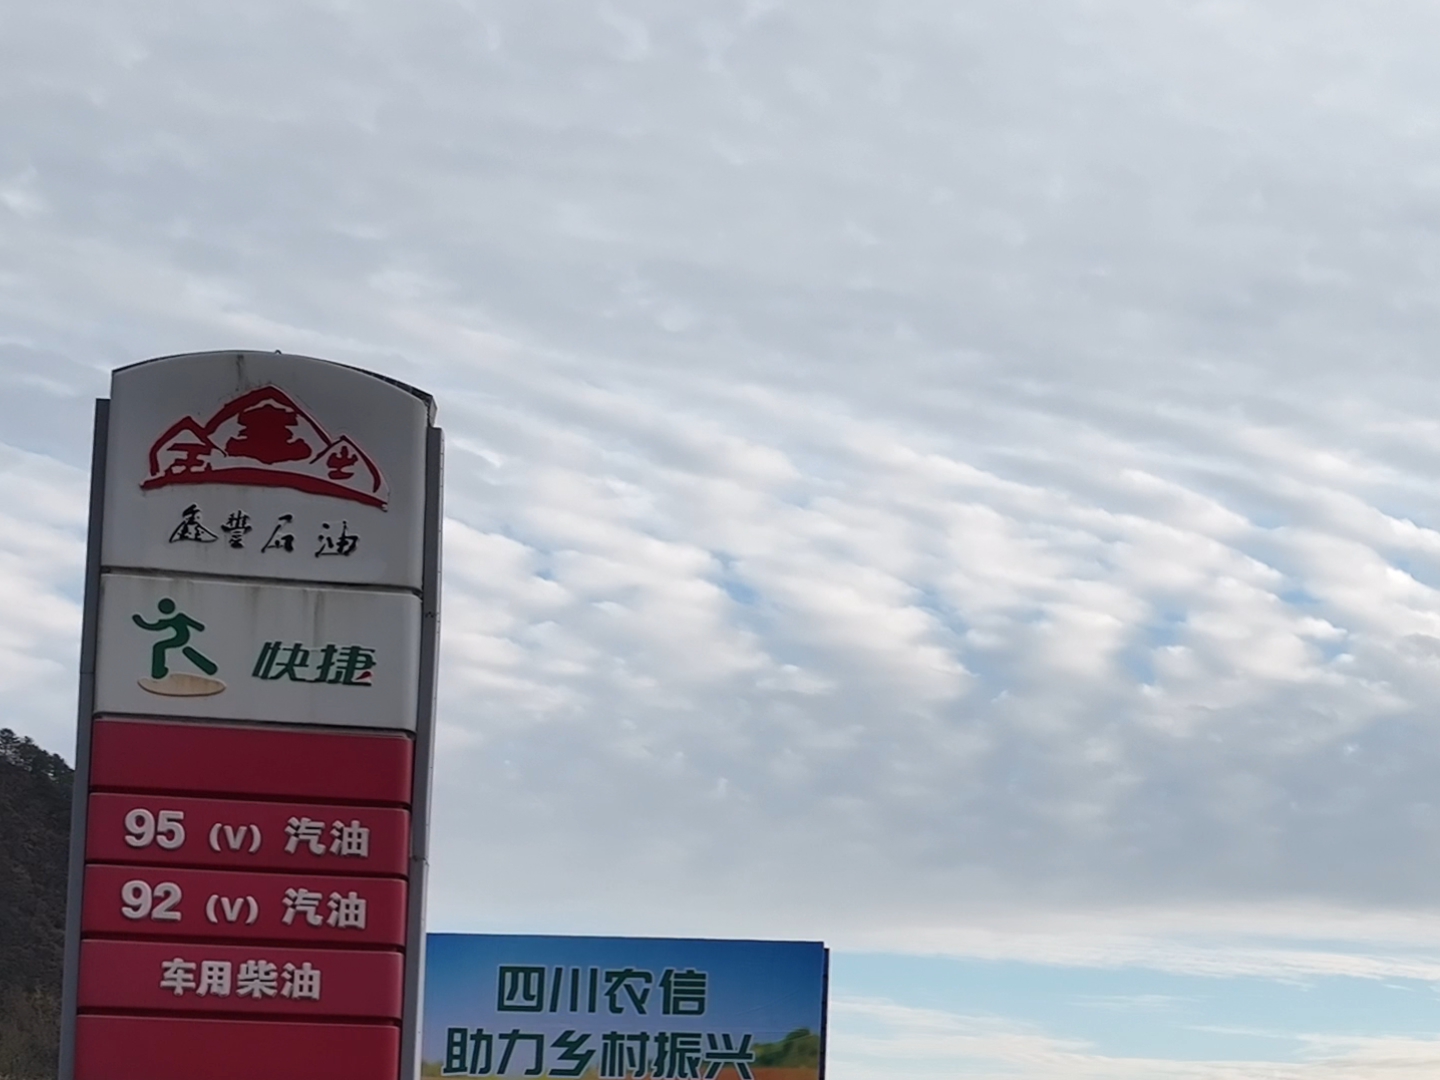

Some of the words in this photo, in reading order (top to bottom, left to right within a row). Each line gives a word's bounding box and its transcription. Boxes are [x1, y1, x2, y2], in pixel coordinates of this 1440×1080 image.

[251, 641, 377, 687] 快捷
[124, 808, 185, 849] 95
[284, 817, 370, 857] 汽油
[121, 880, 182, 921] 92
[282, 888, 367, 929] 汽油
[160, 958, 321, 1000] 车用柴油
[496, 964, 708, 1016] 四川农信
